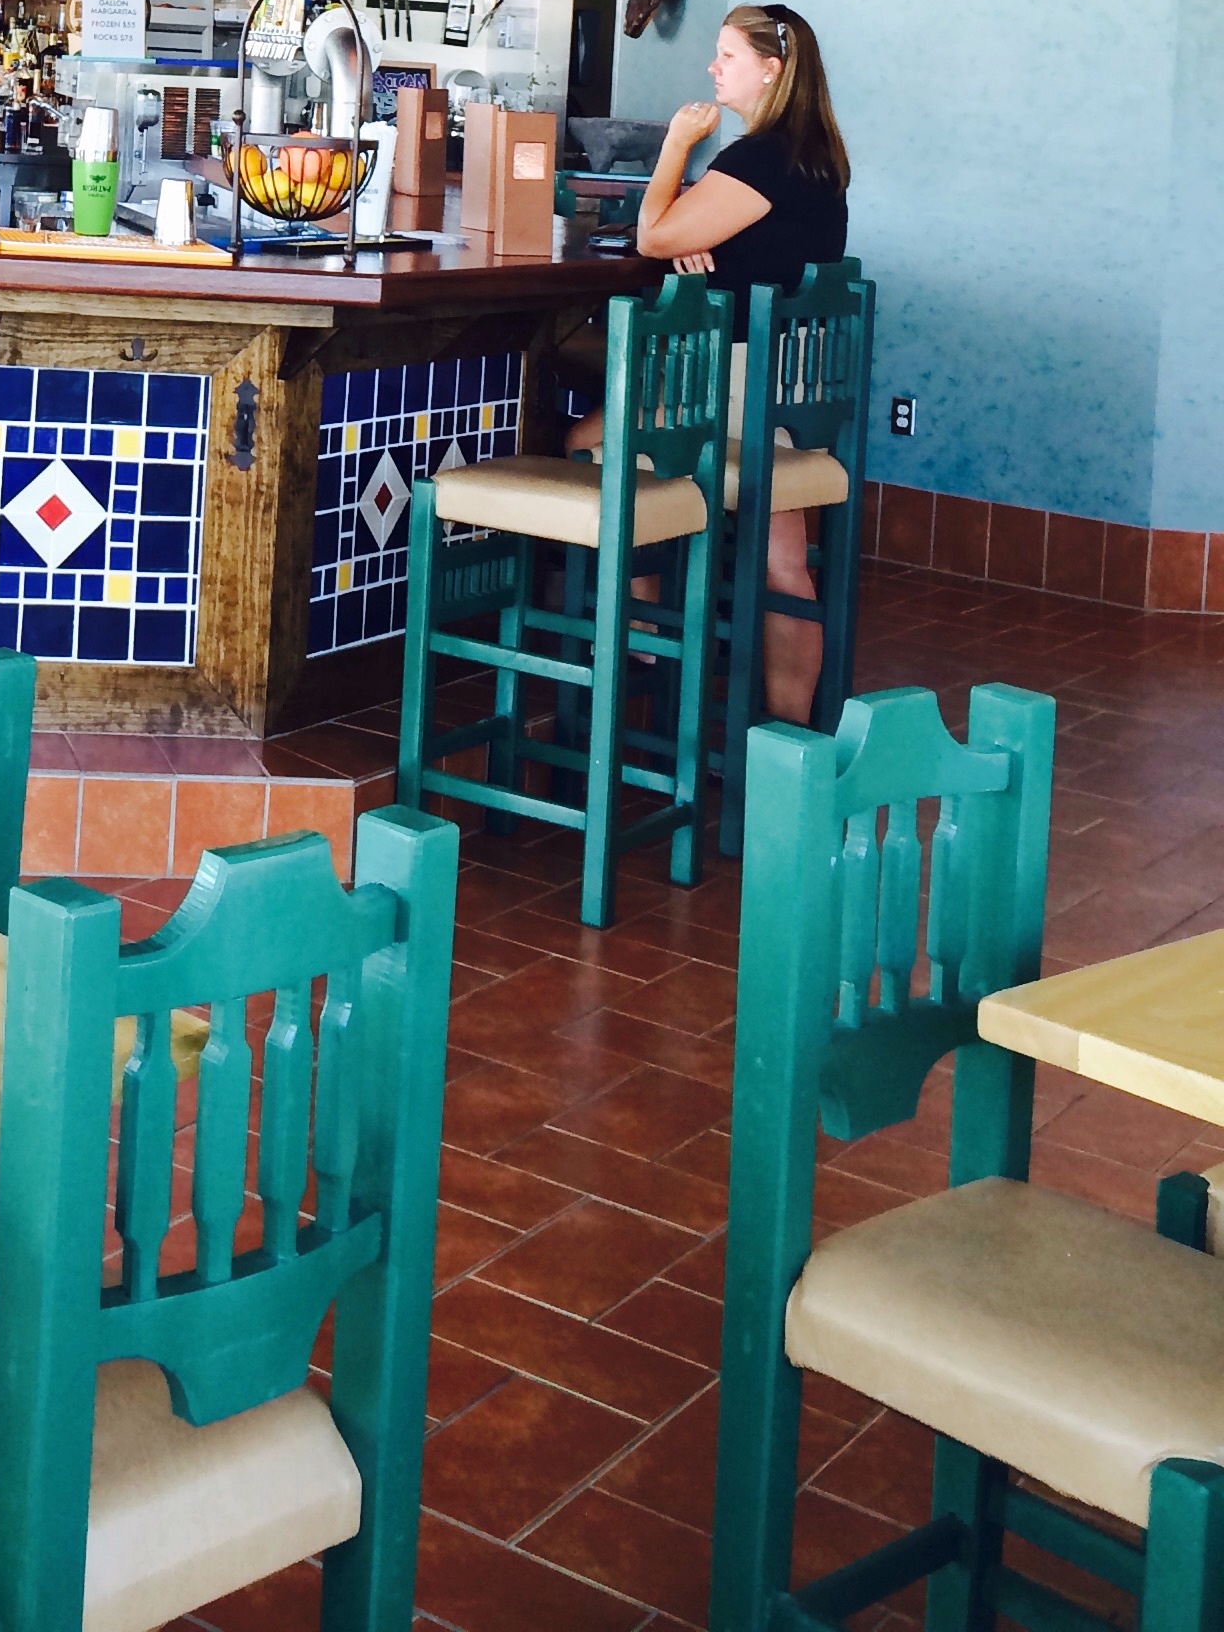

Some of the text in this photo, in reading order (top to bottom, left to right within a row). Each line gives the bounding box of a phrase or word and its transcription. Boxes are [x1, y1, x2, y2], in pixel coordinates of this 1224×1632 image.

[98, 0, 129, 7] GALLON
[90, 7, 137, 16] MARGARITAS
[91, 20, 121, 28] FROZEN
[93, 33, 118, 41] ROCKS
